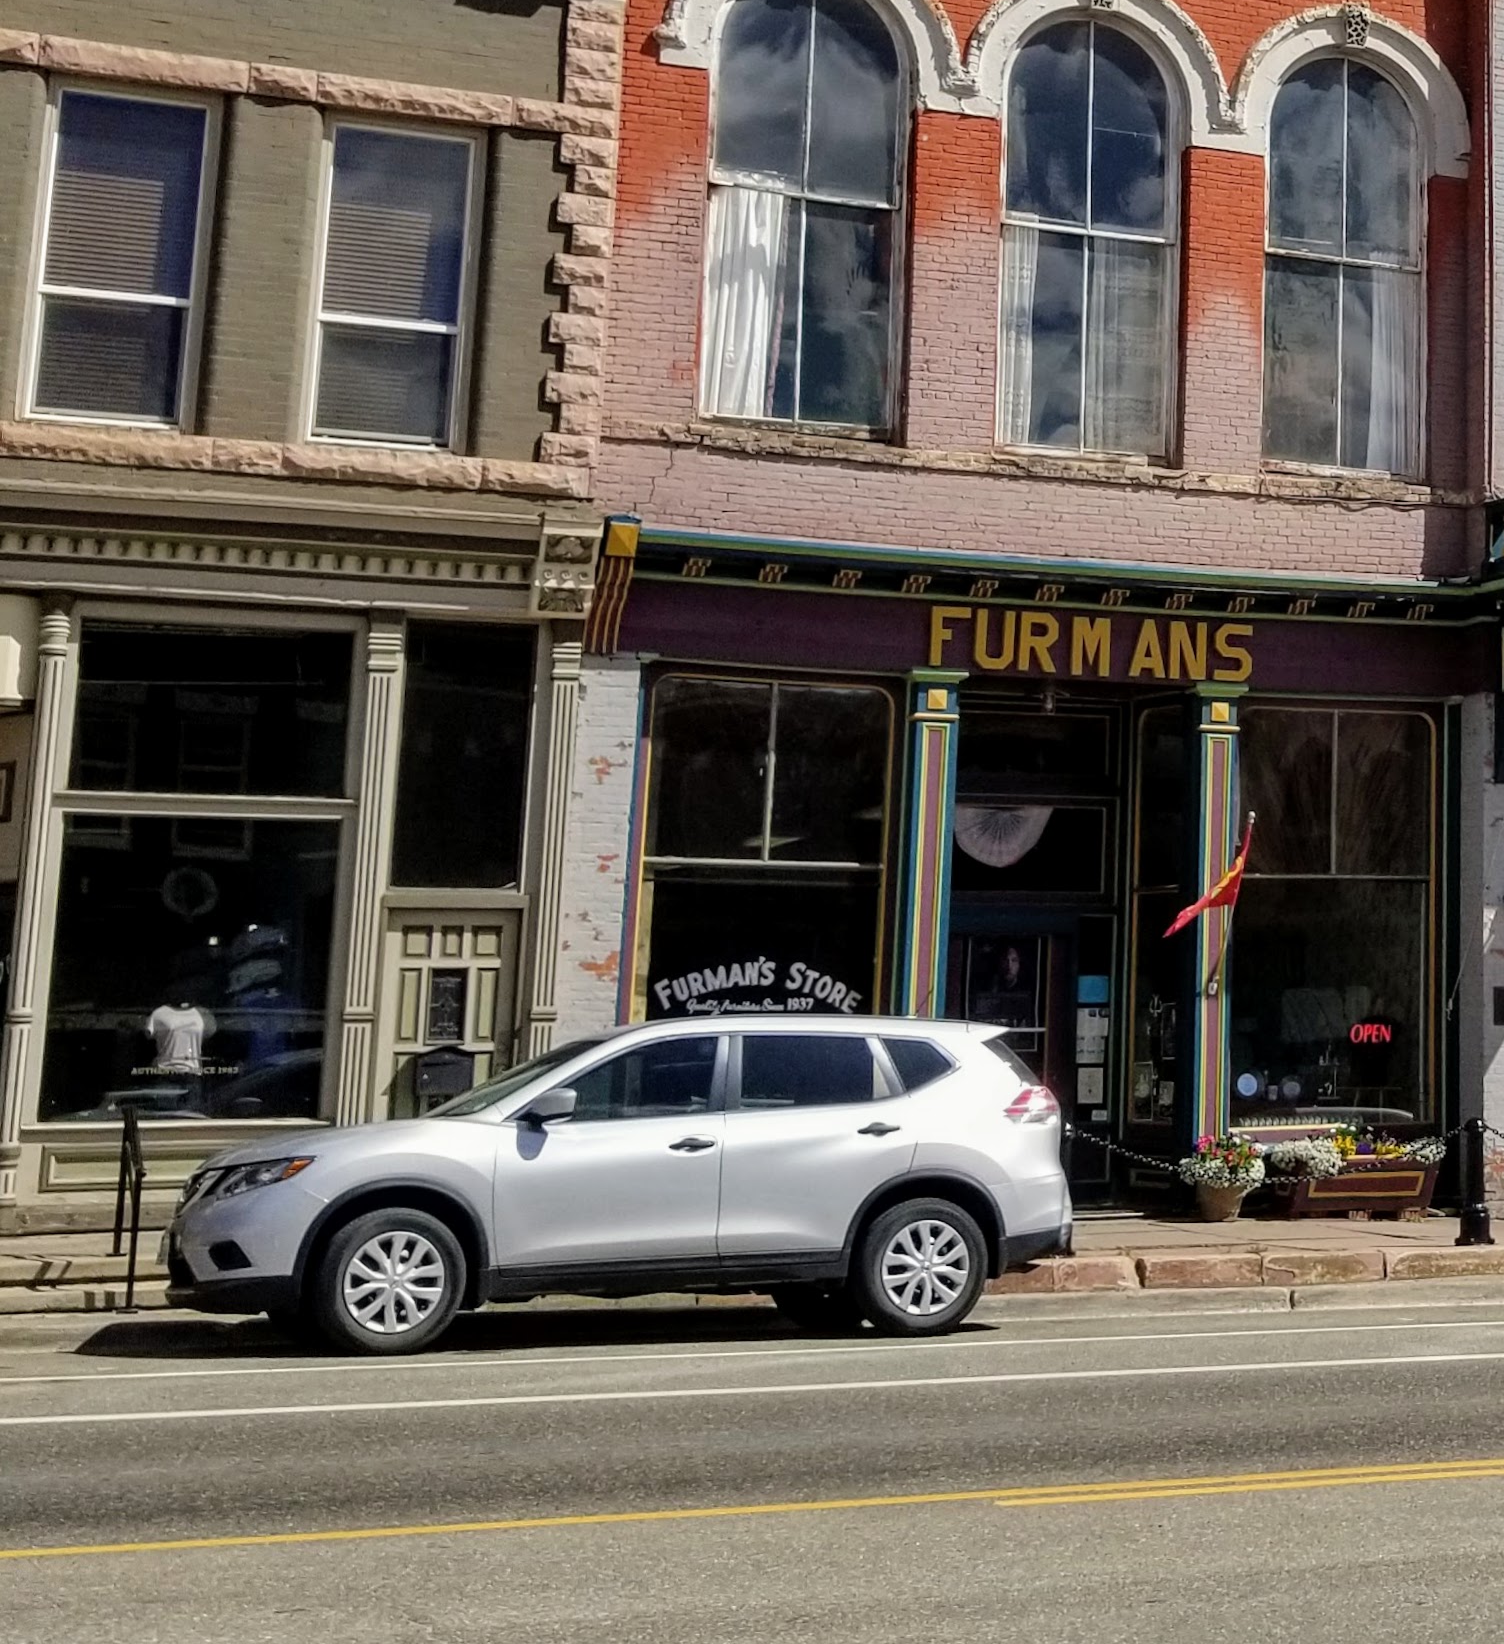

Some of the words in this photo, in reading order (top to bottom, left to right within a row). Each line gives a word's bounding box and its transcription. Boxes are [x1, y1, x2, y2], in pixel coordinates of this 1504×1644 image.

[928, 605, 1255, 683] FURMANS
[654, 956, 777, 1011] FURMAN'S
[785, 962, 864, 1014] STORE
[787, 997, 815, 1011] 1937
[1350, 1023, 1392, 1044] OPEN
